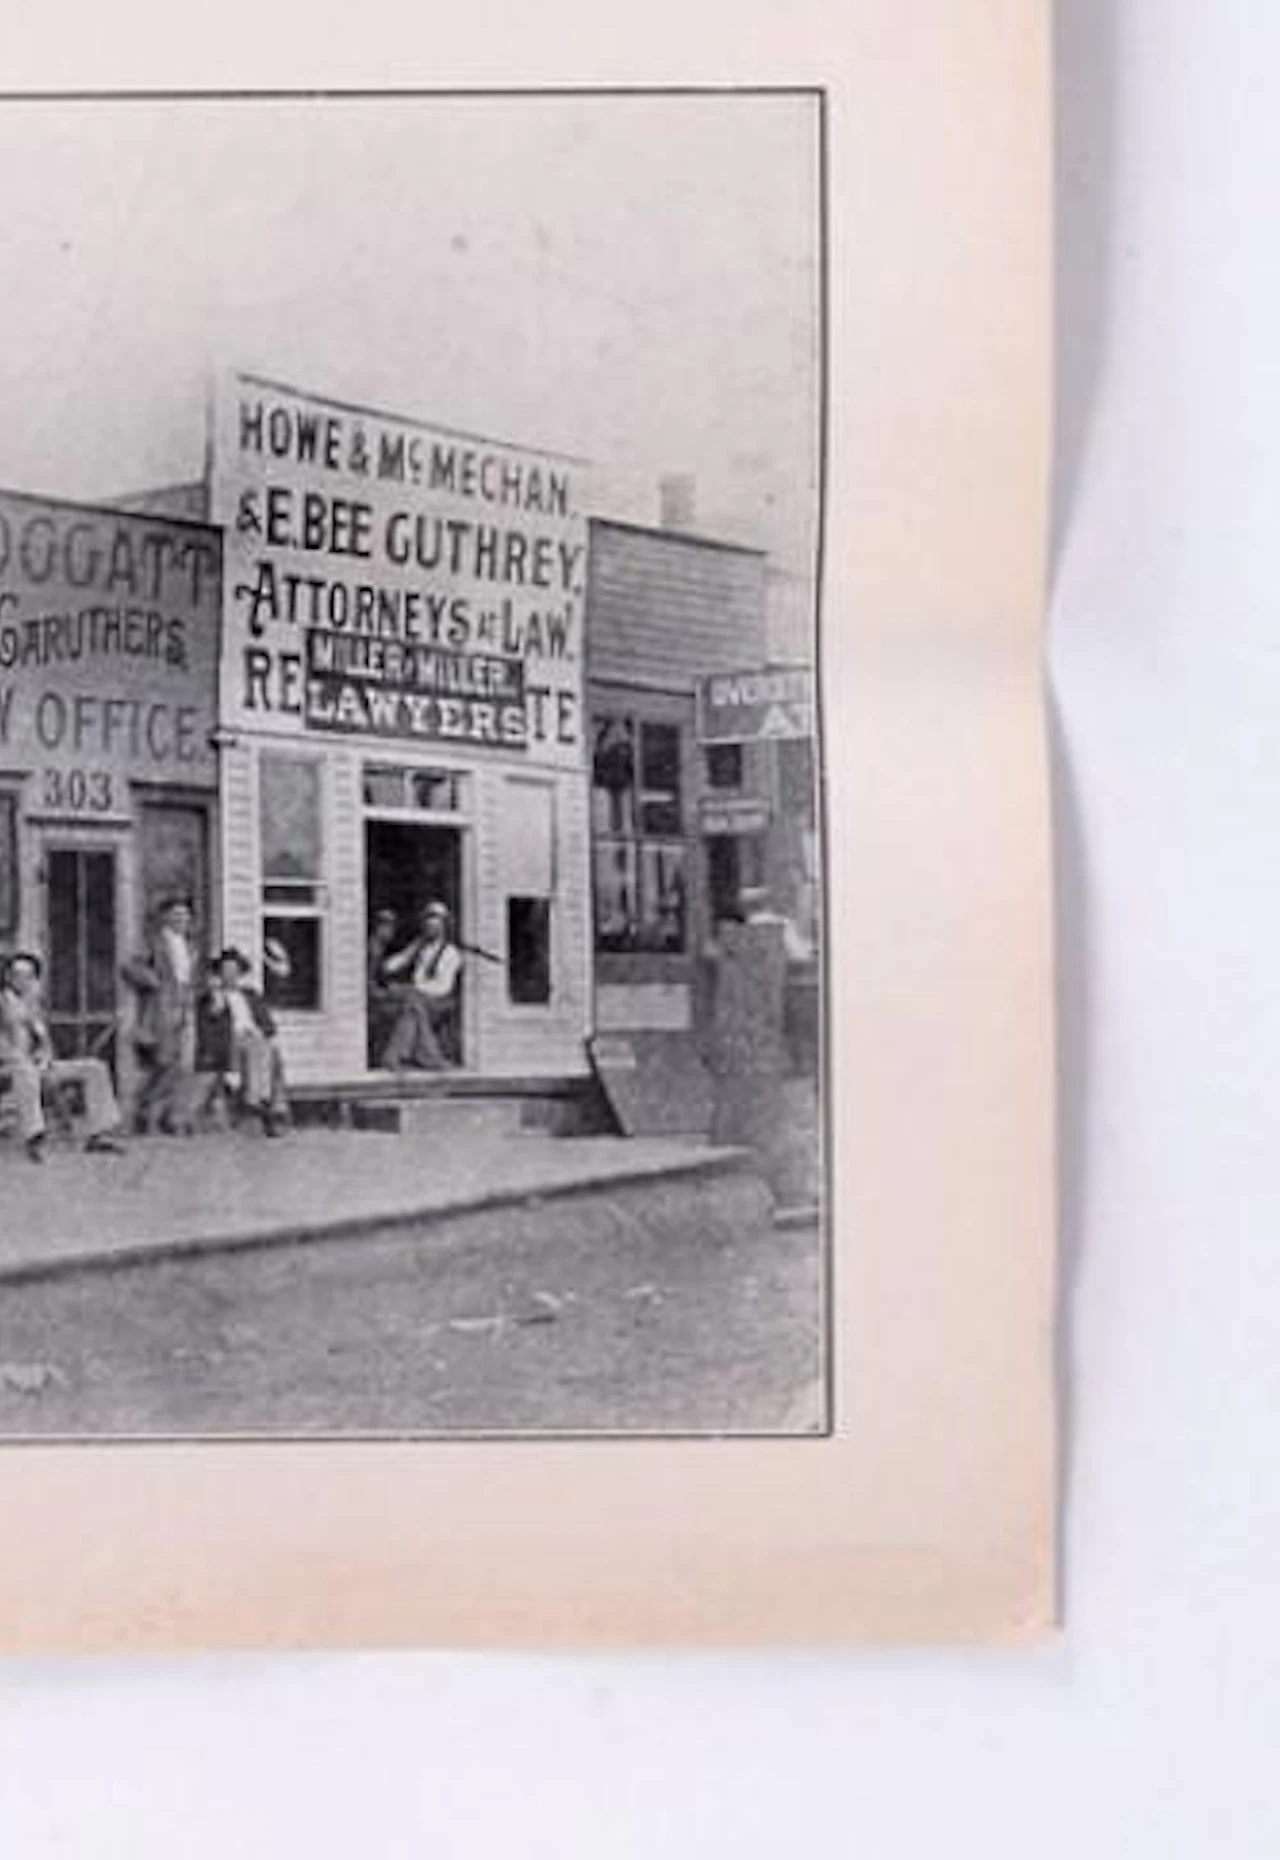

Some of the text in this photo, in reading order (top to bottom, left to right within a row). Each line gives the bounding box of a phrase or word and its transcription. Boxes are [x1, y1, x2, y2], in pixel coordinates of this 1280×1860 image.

[241, 402, 340, 470] HOWE
[347, 426, 371, 476] &
[235, 559, 470, 646] ATTORNEYS
[308, 636, 403, 682] MILLER
[307, 679, 526, 743] LAWYERS
[43, 768, 114, 812] 303
